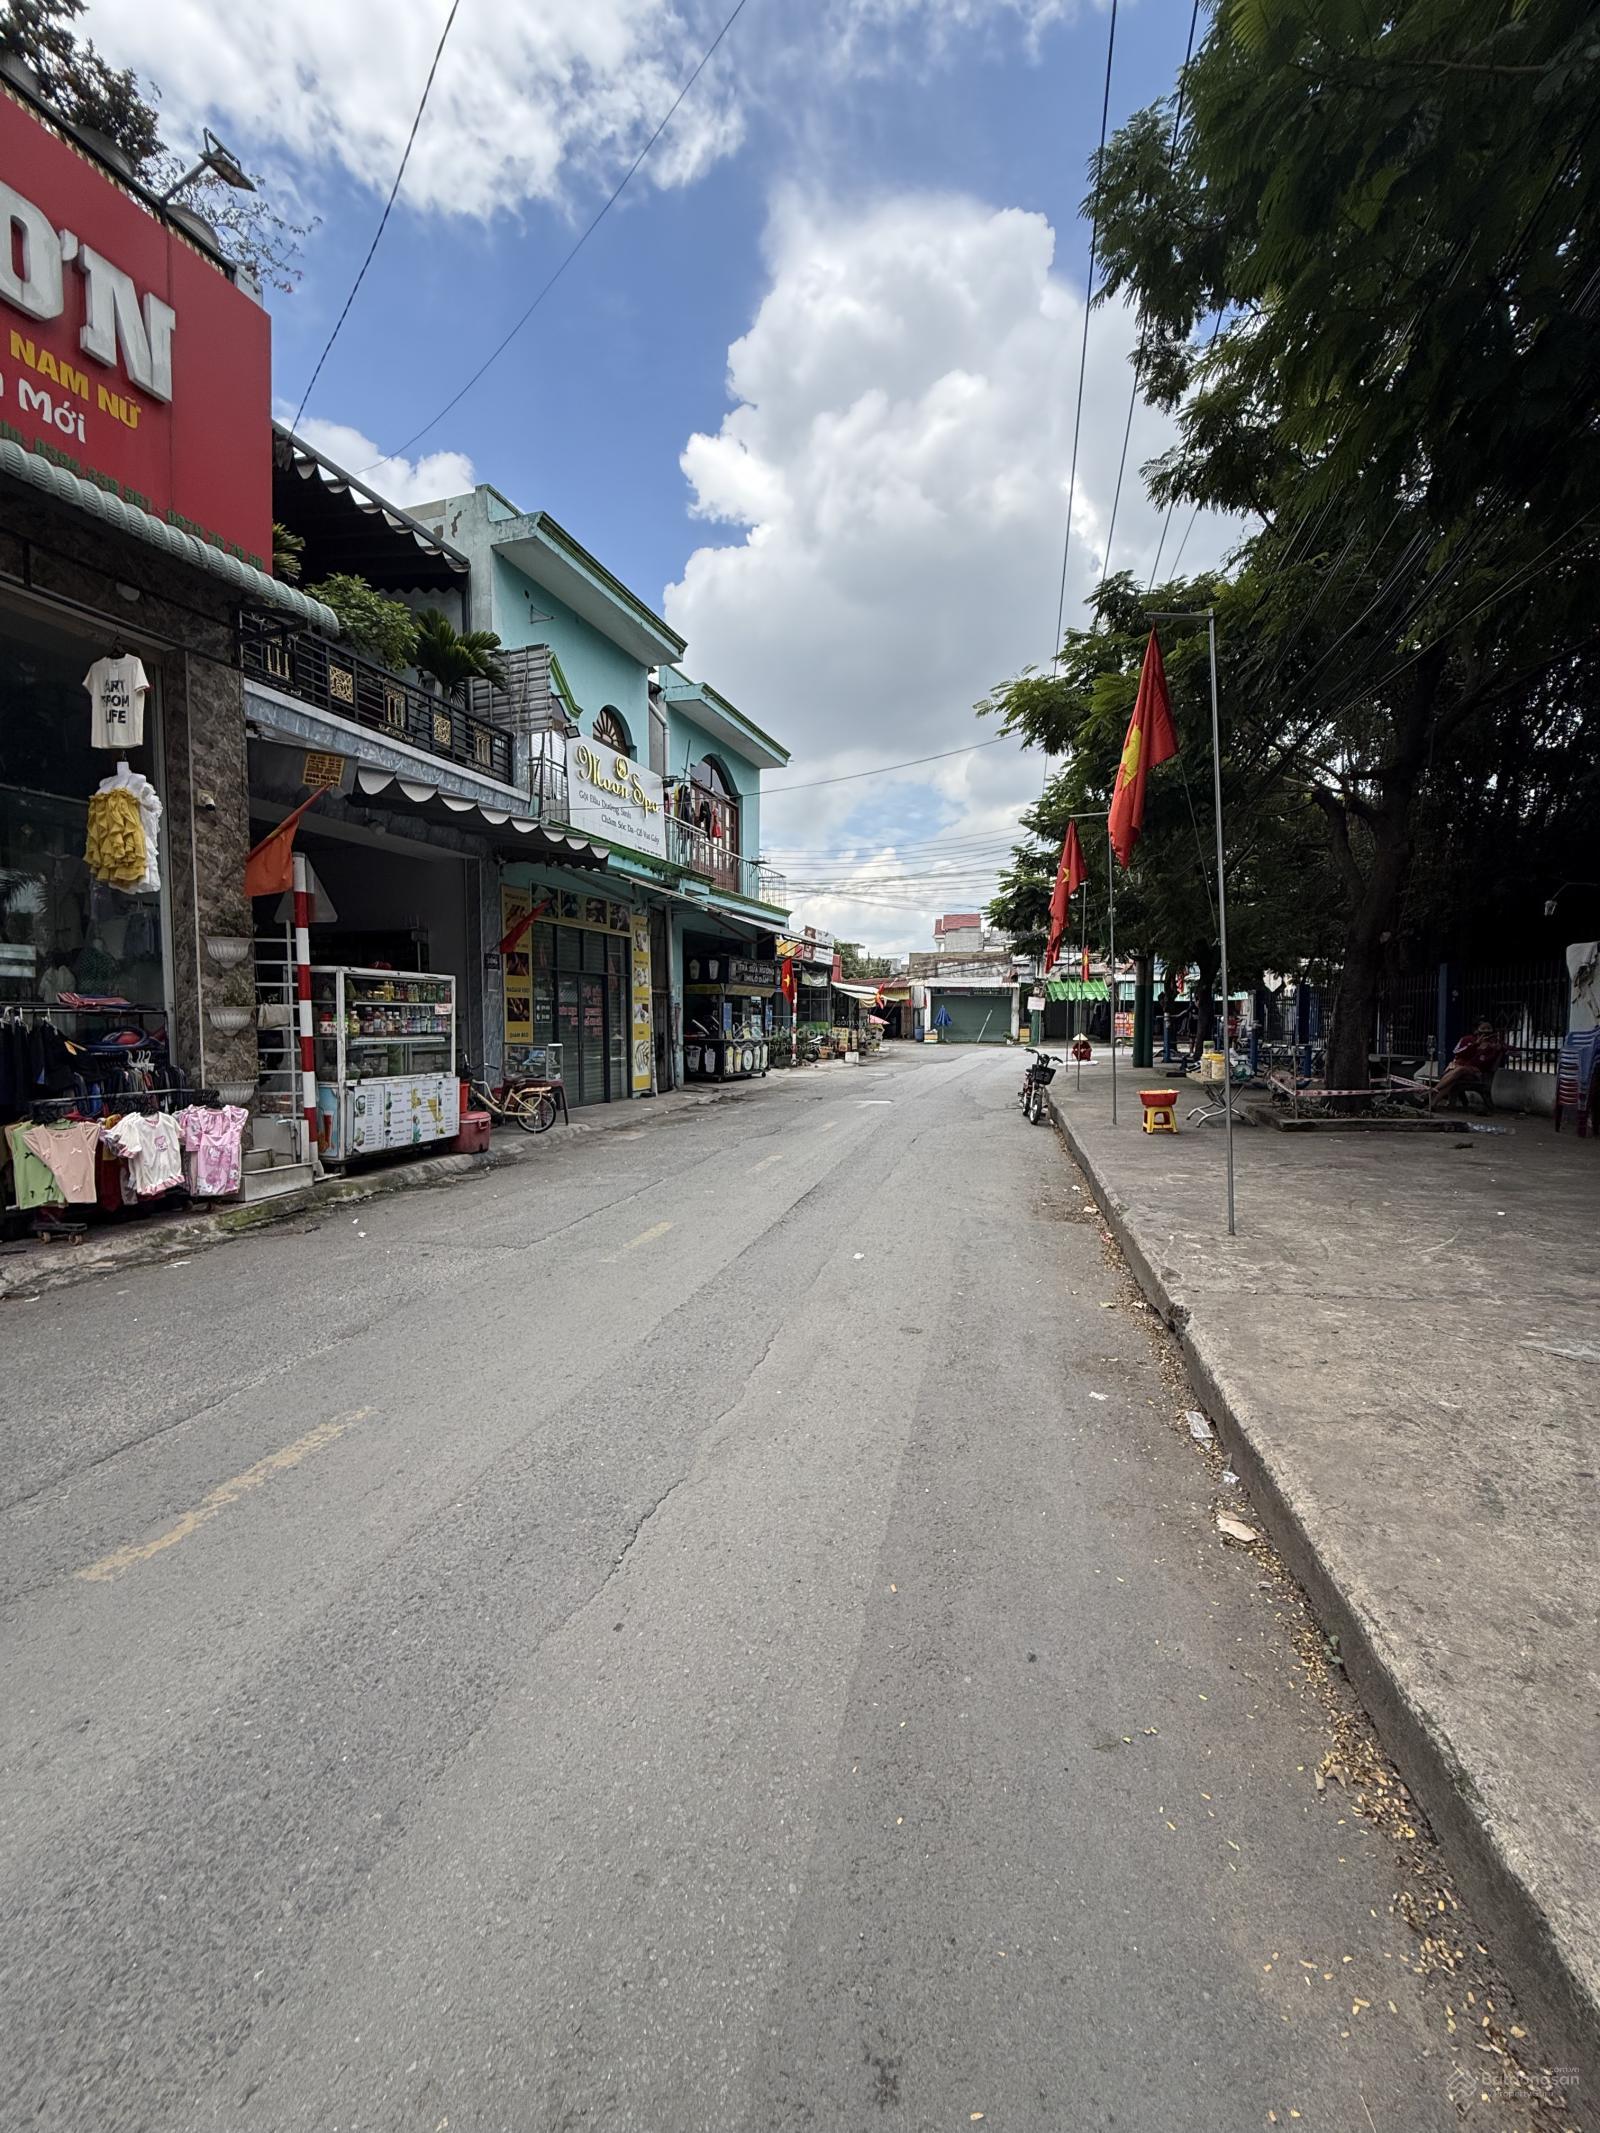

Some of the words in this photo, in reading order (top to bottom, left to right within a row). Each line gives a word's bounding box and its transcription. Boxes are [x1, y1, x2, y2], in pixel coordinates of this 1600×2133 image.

[10, 329, 90, 401] NAM
[97, 383, 142, 429] NỮ
[19, 377, 87, 444] Mới
[104, 679, 125, 693] ART
[576, 743, 631, 799] Moon
[631, 773, 661, 818] Spa
